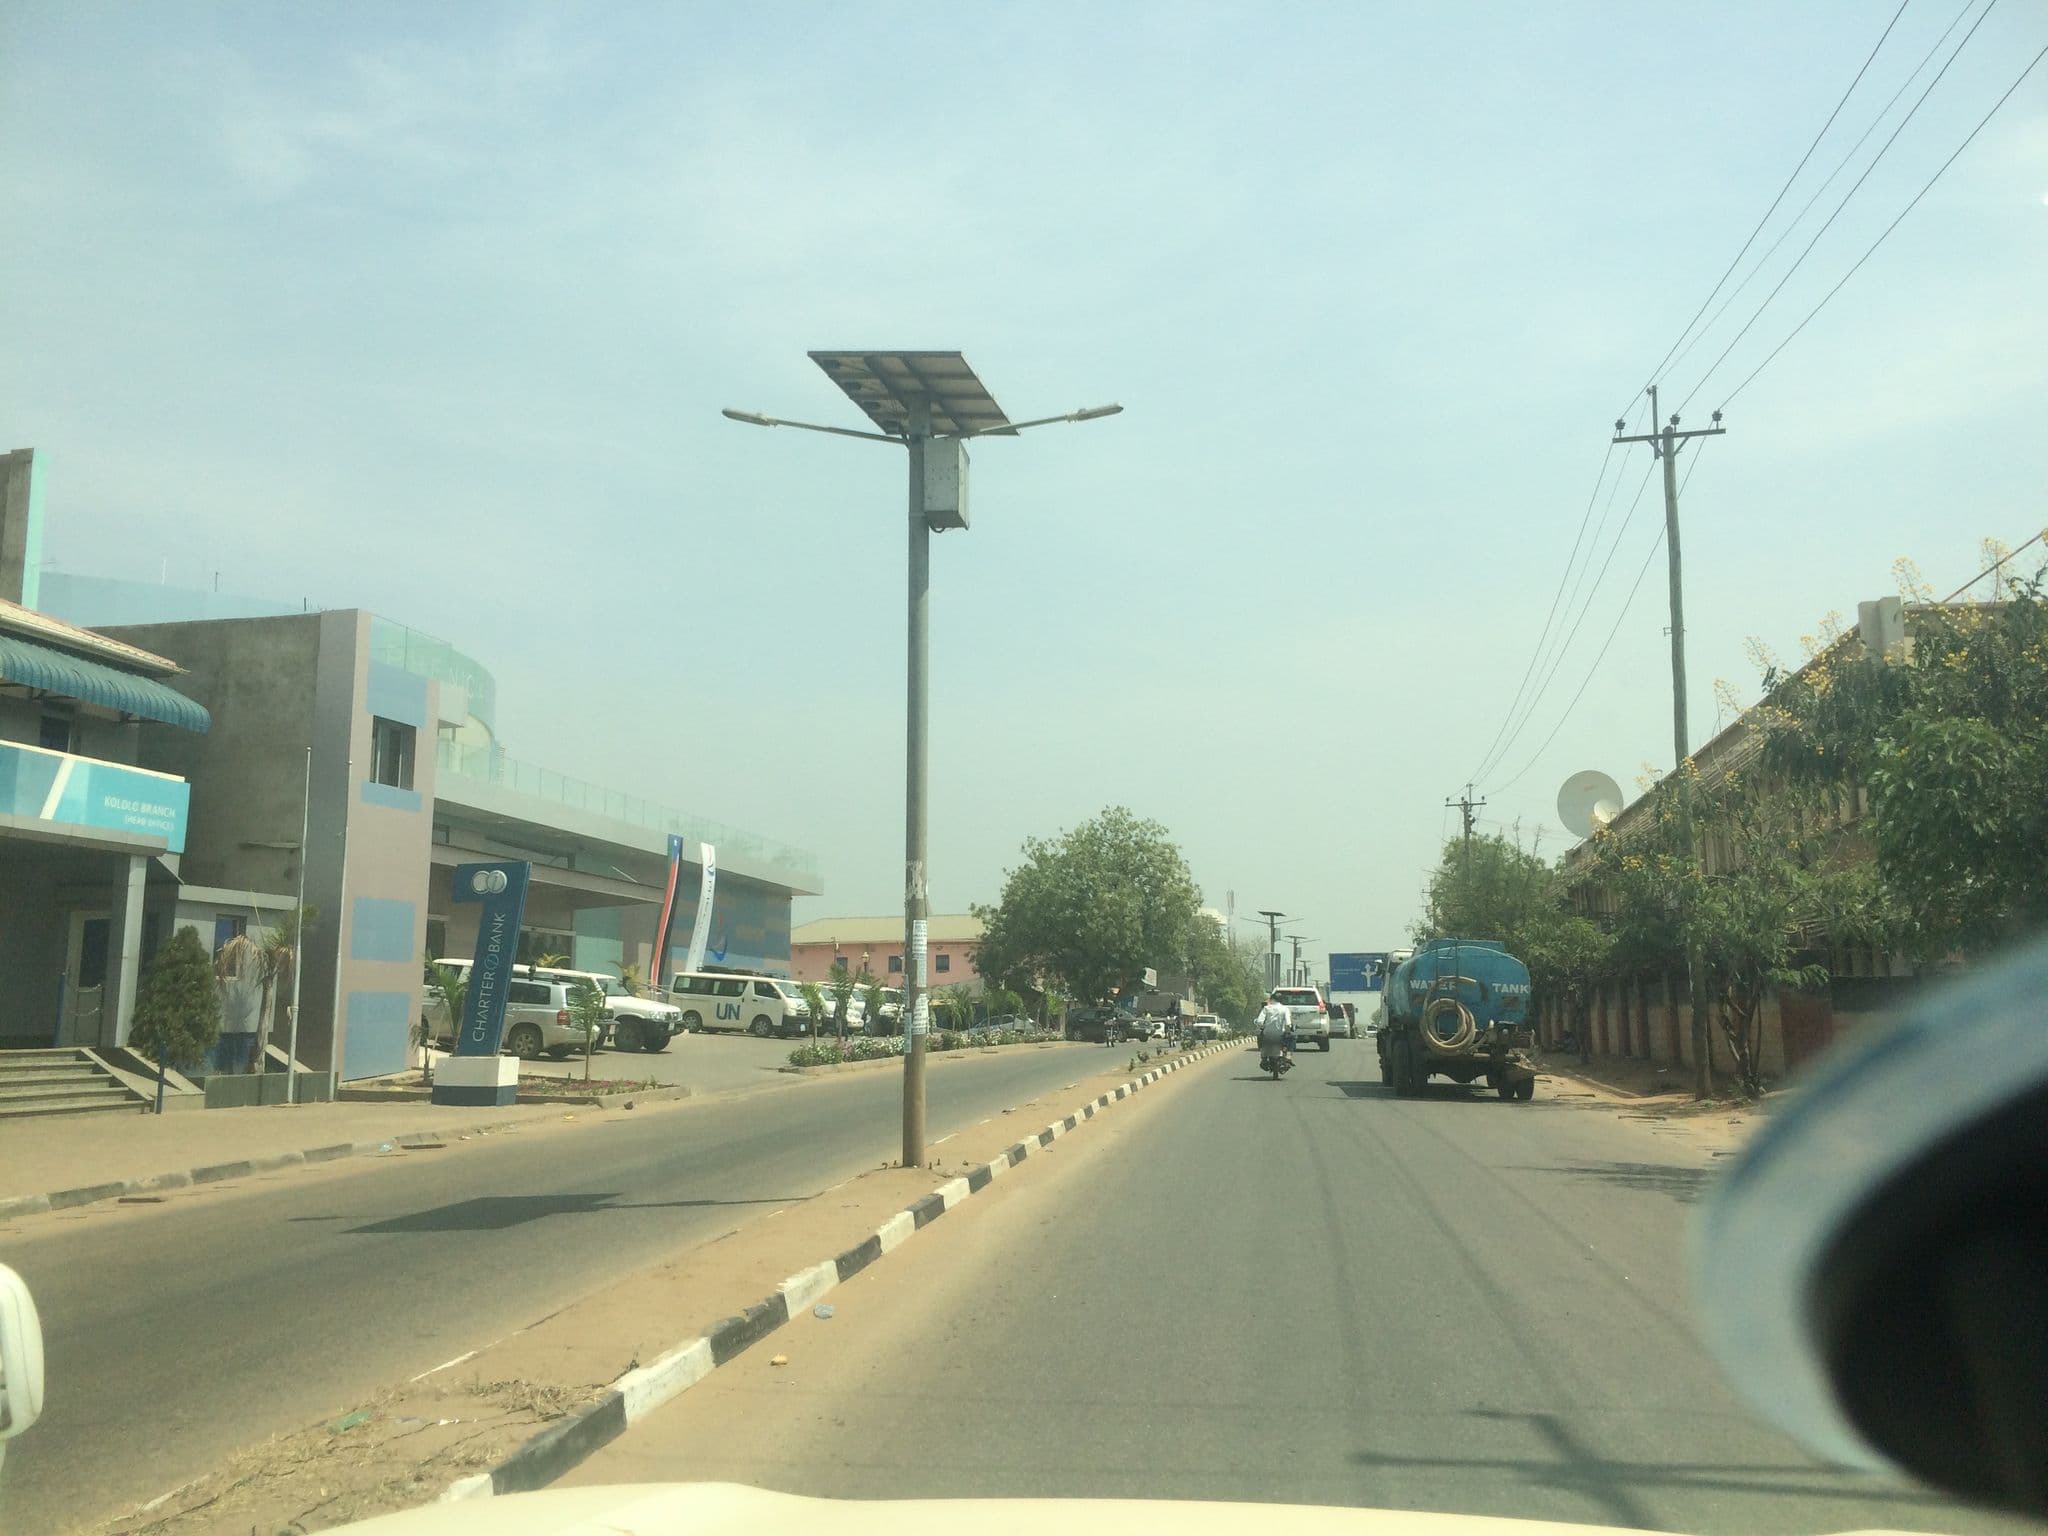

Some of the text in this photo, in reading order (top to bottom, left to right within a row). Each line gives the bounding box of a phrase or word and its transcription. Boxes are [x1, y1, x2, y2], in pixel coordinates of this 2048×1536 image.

[104, 795, 176, 818] KOLOLO BRANCH
[472, 912, 506, 1042] CHARTER BANK
[1492, 983, 1529, 994] TANK
[716, 1002, 741, 1020] UN
